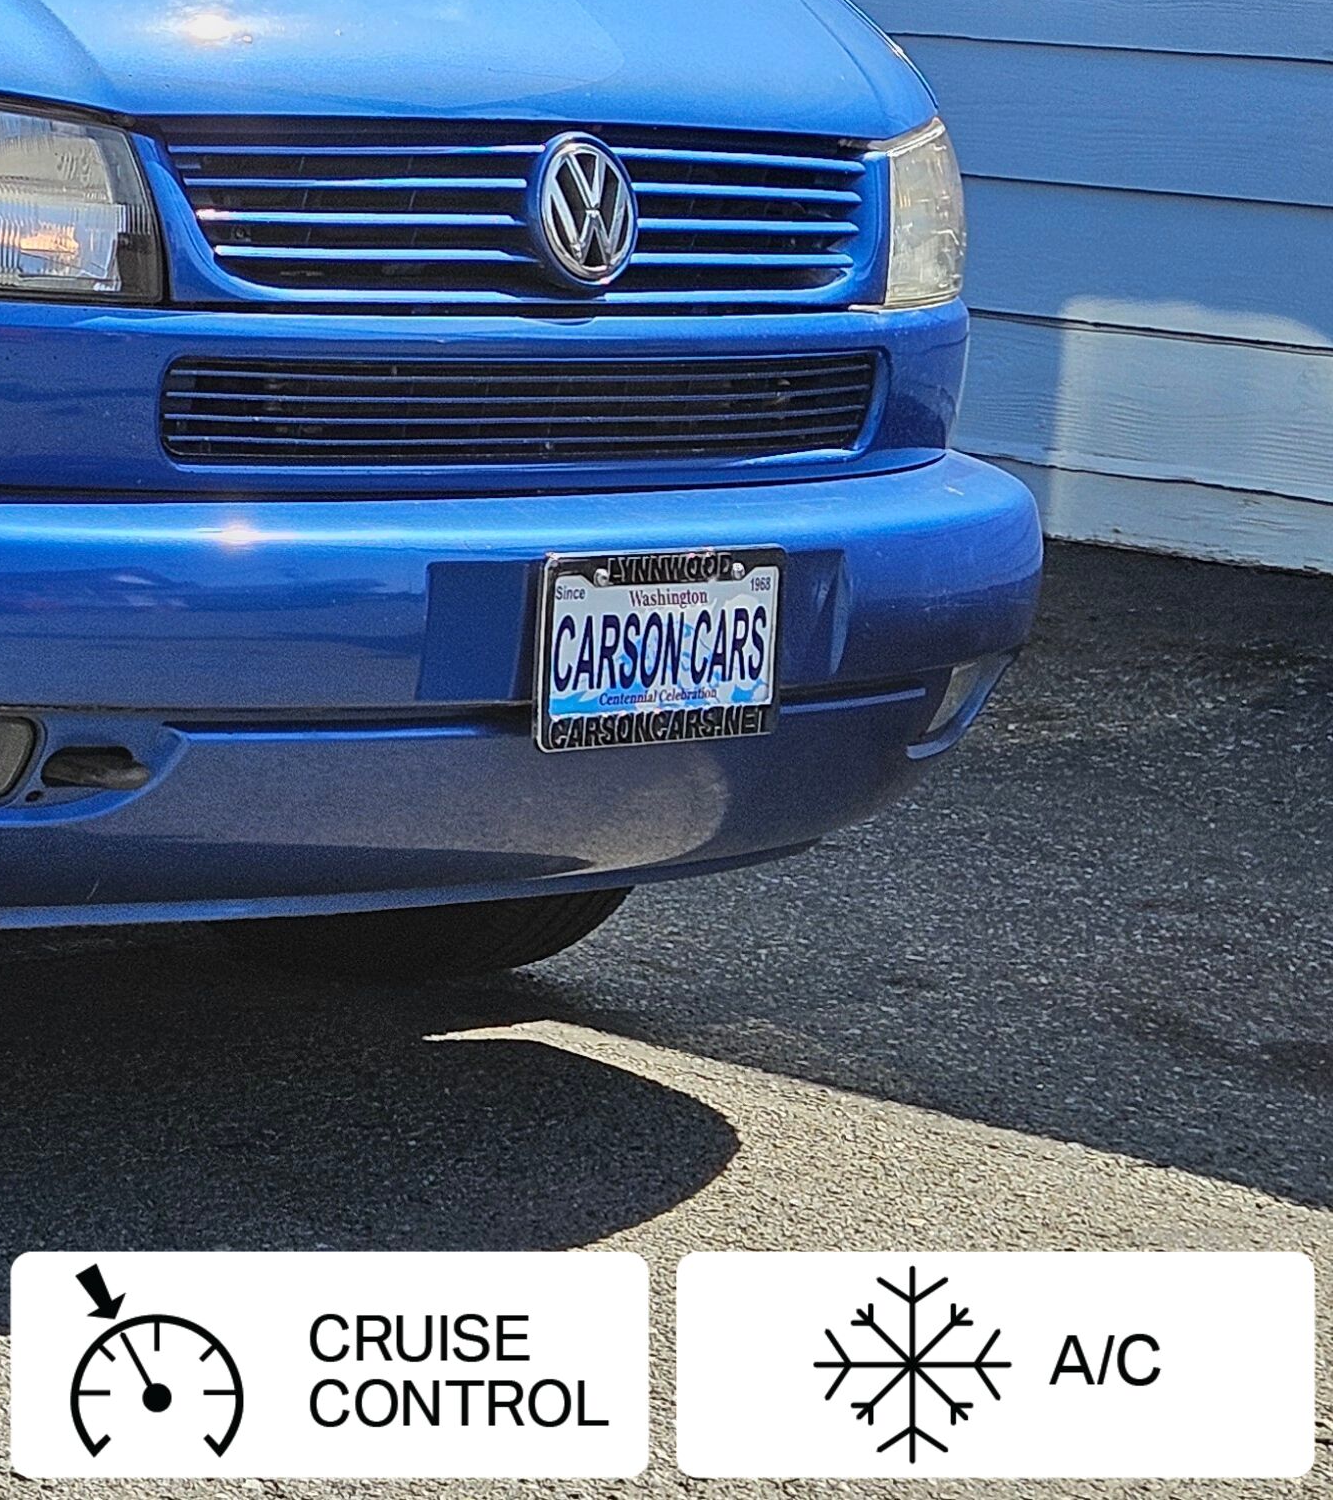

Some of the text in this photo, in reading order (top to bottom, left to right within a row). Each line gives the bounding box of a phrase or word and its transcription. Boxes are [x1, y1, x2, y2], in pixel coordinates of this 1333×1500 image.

[606, 553, 733, 584] LYNNWOOD
[555, 585, 586, 601] Since
[628, 588, 708, 609] Washington
[553, 605, 767, 693] CARSON CARS
[598, 687, 718, 706] Centennial Celebration
[548, 705, 770, 748] CARSONCARS.NET
